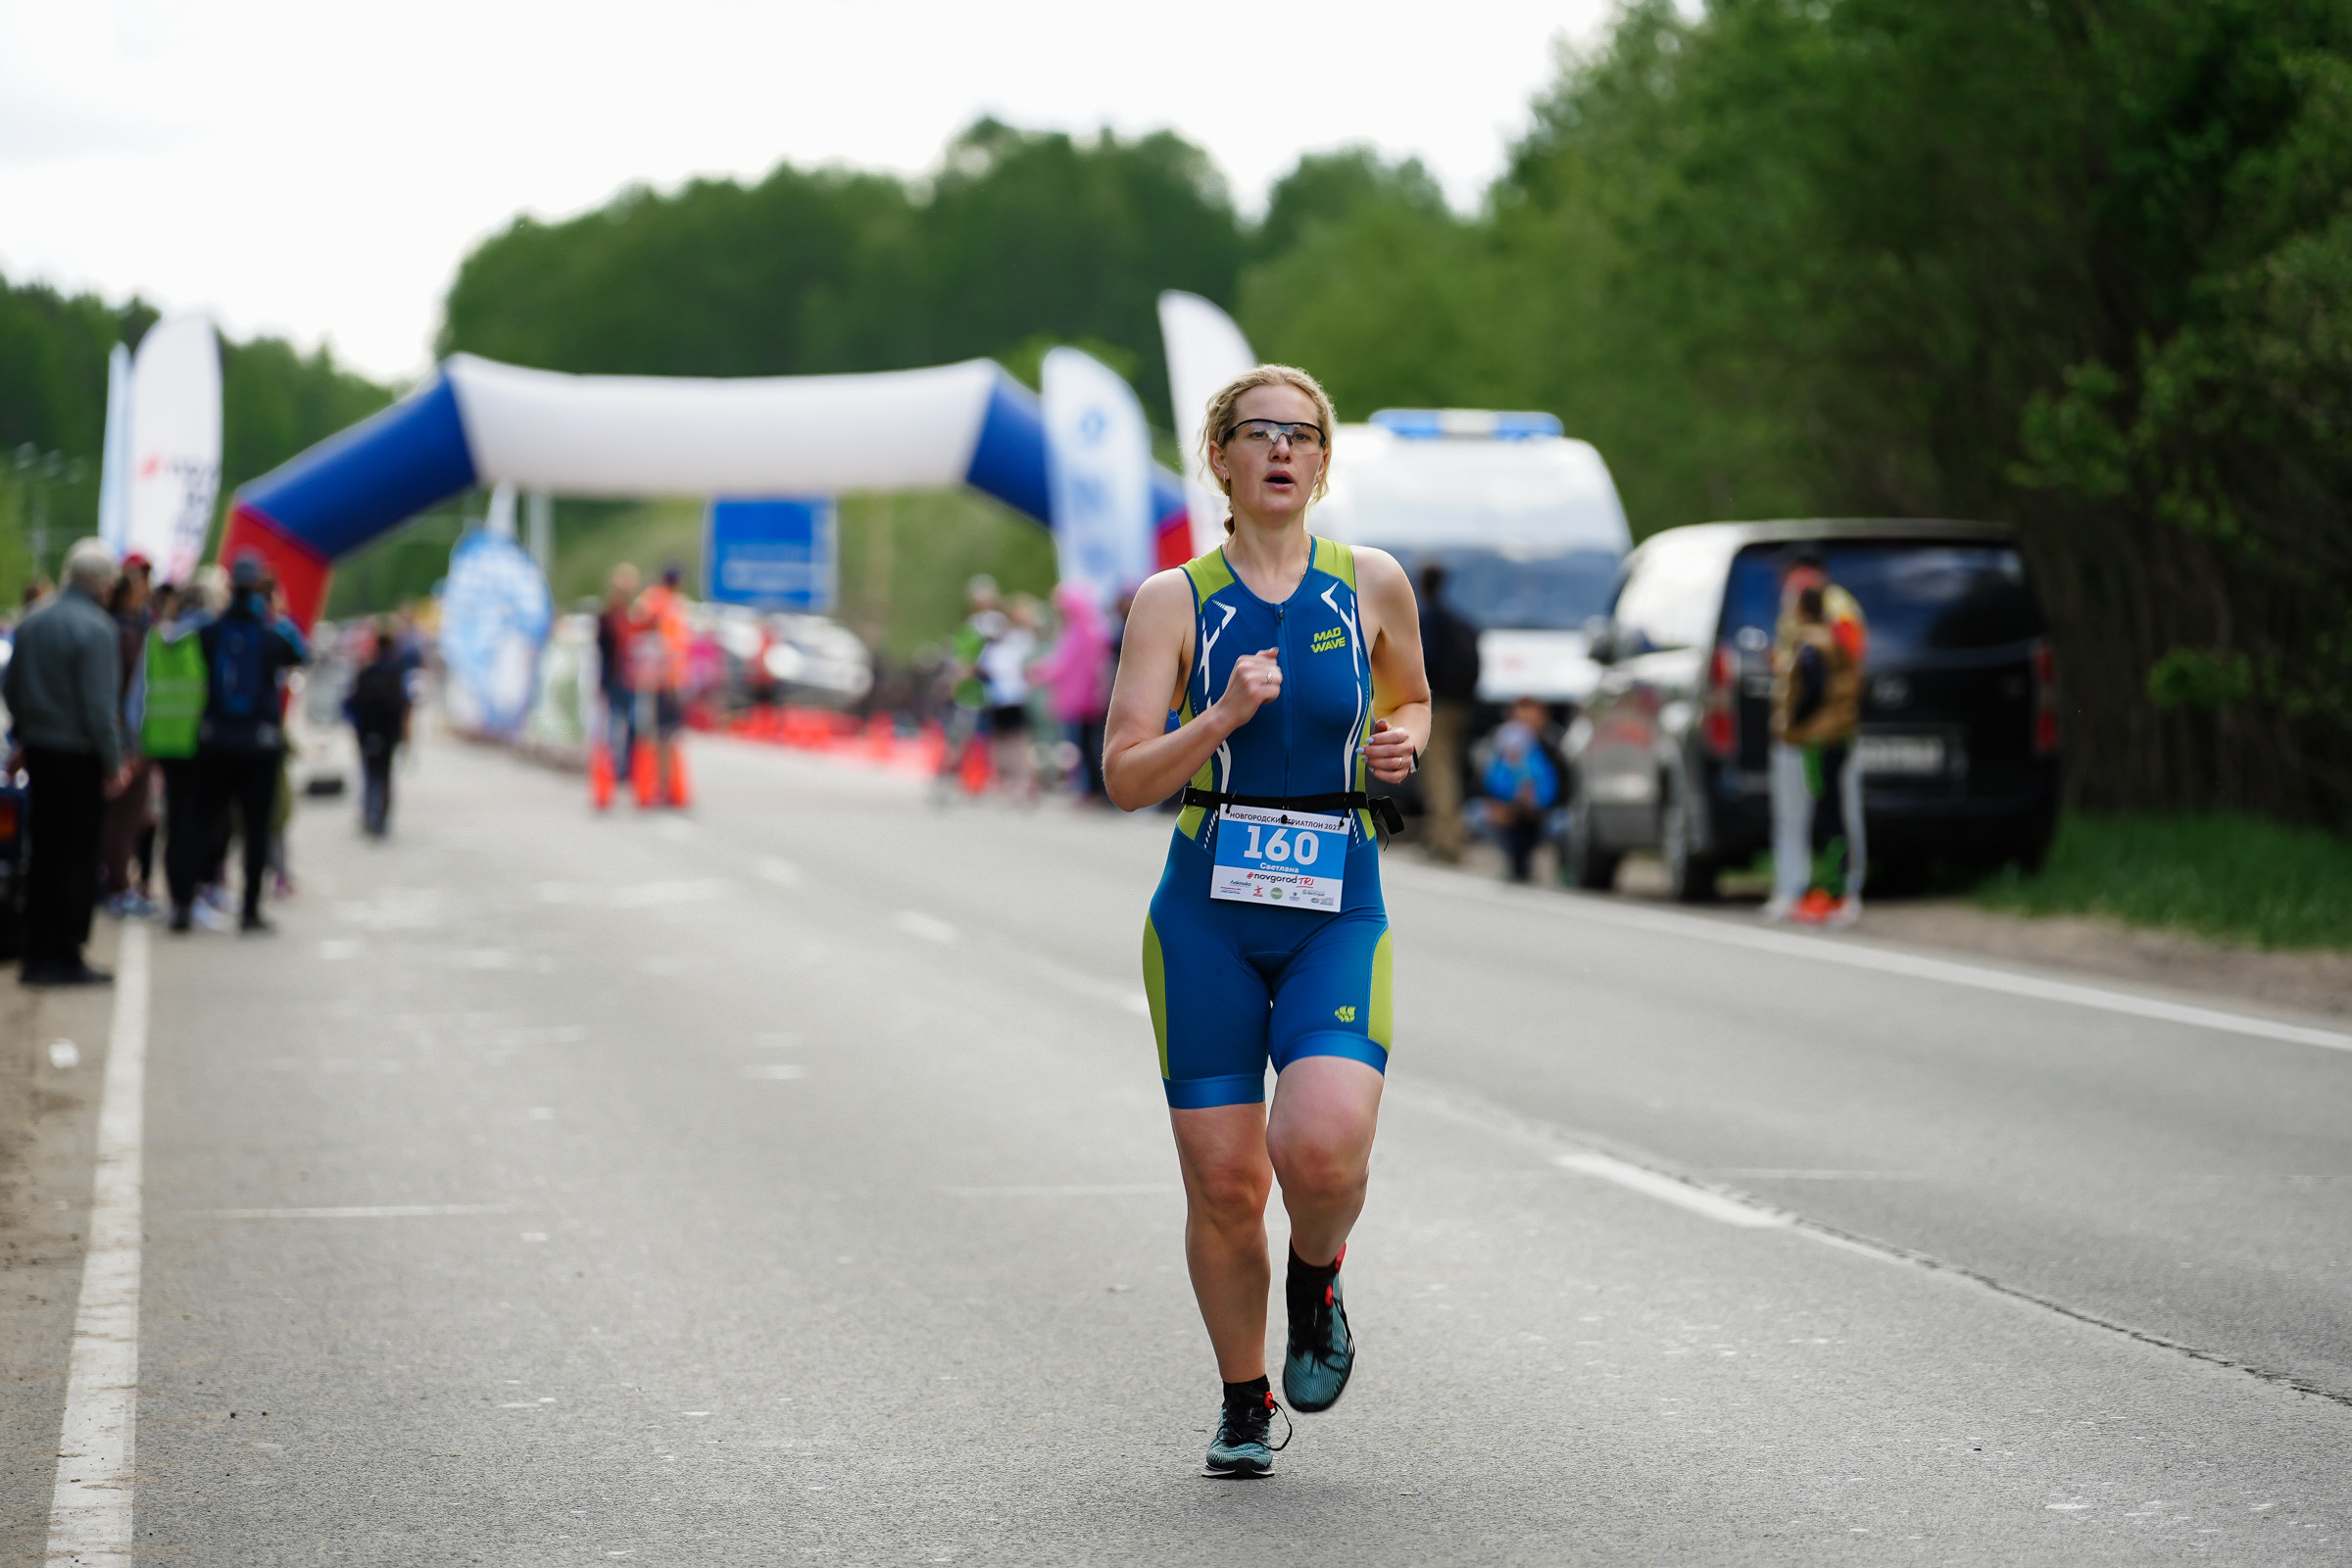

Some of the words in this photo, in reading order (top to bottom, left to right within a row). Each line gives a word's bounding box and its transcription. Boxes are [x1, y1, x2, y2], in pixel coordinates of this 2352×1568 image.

[1313, 626, 1342, 643] MAD
[1310, 636, 1346, 654] WAVE
[1229, 811, 1287, 824] НОВГОРОДСКИ
[1243, 824, 1320, 865] 160
[1259, 861, 1299, 874] Светлана
